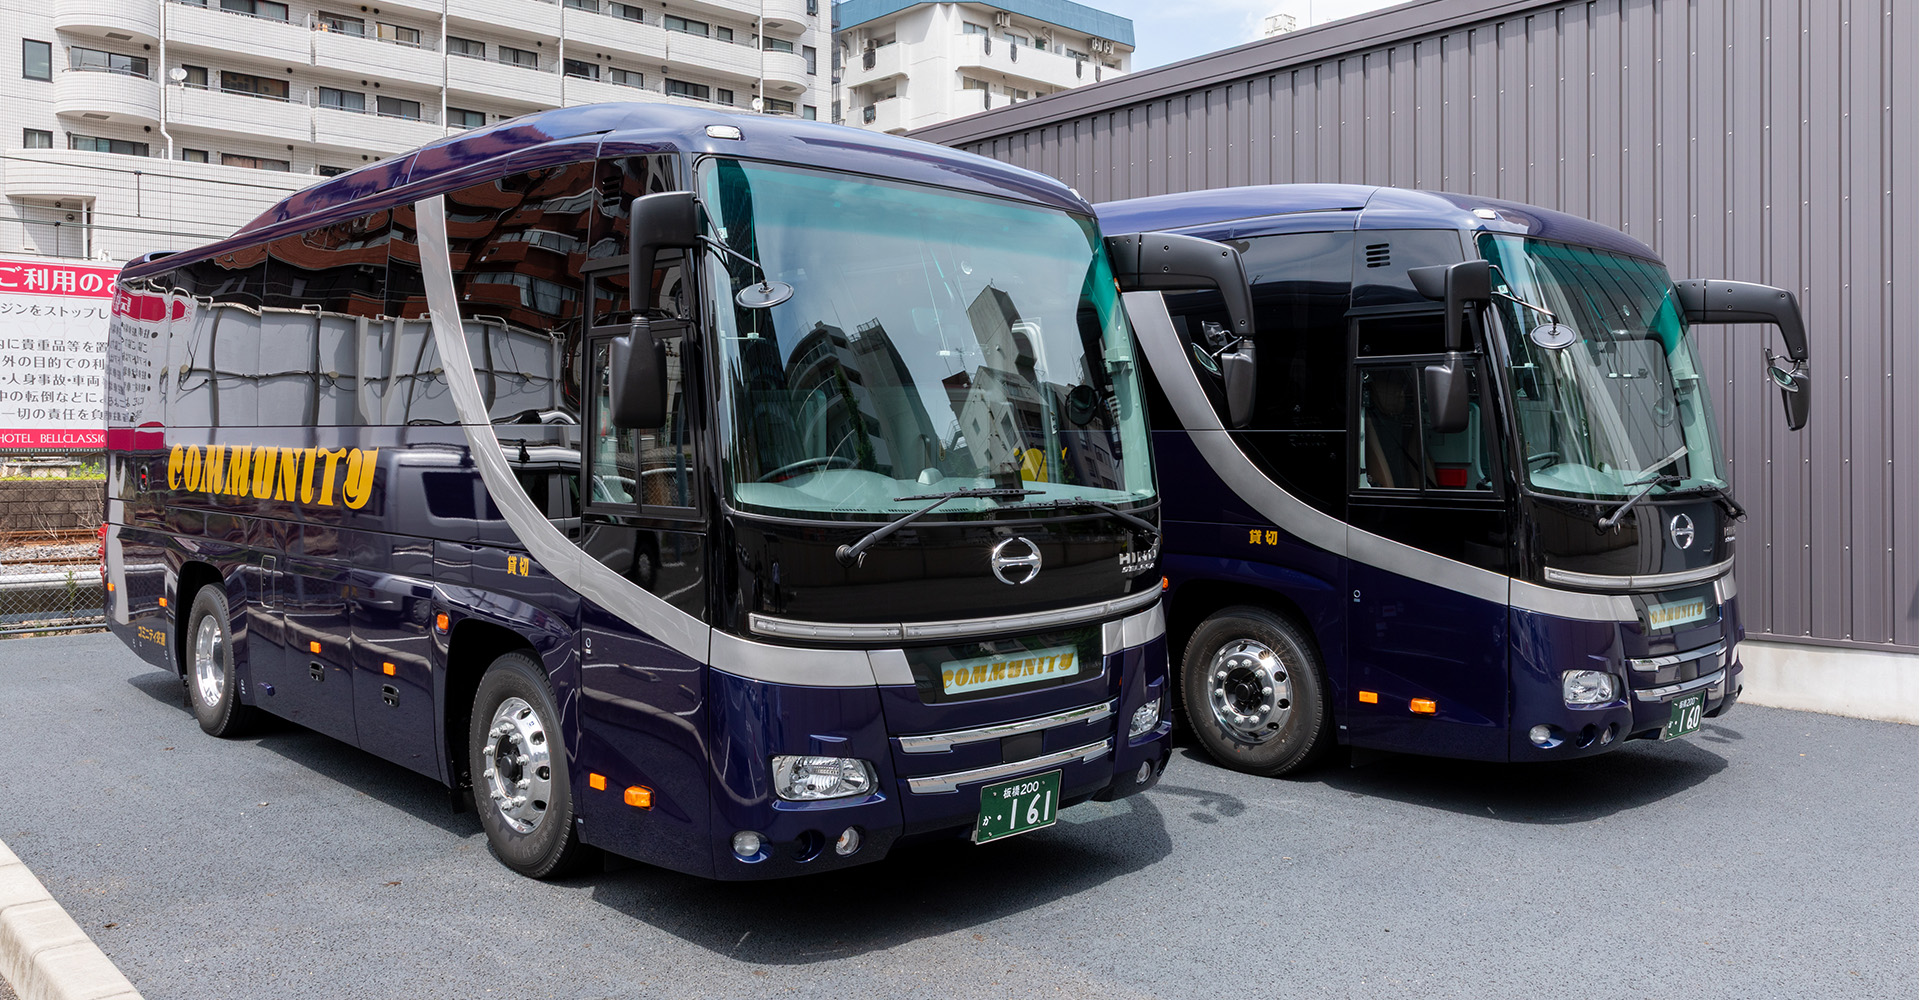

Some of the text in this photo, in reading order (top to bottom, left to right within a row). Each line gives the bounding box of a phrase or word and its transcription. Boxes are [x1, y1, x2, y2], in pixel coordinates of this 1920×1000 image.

[1, 302, 109, 320] ジンをストップし
[2, 355, 105, 370] 外の目的での利
[167, 442, 380, 510] COMMUNITY
[1249, 529, 1278, 545] 貸切
[507, 555, 529, 576] 貸切
[1119, 549, 1157, 565] HINO
[1649, 602, 1704, 625] OMMUNITY
[942, 652, 1075, 689] COMMUNITY
[982, 815, 992, 826] か
